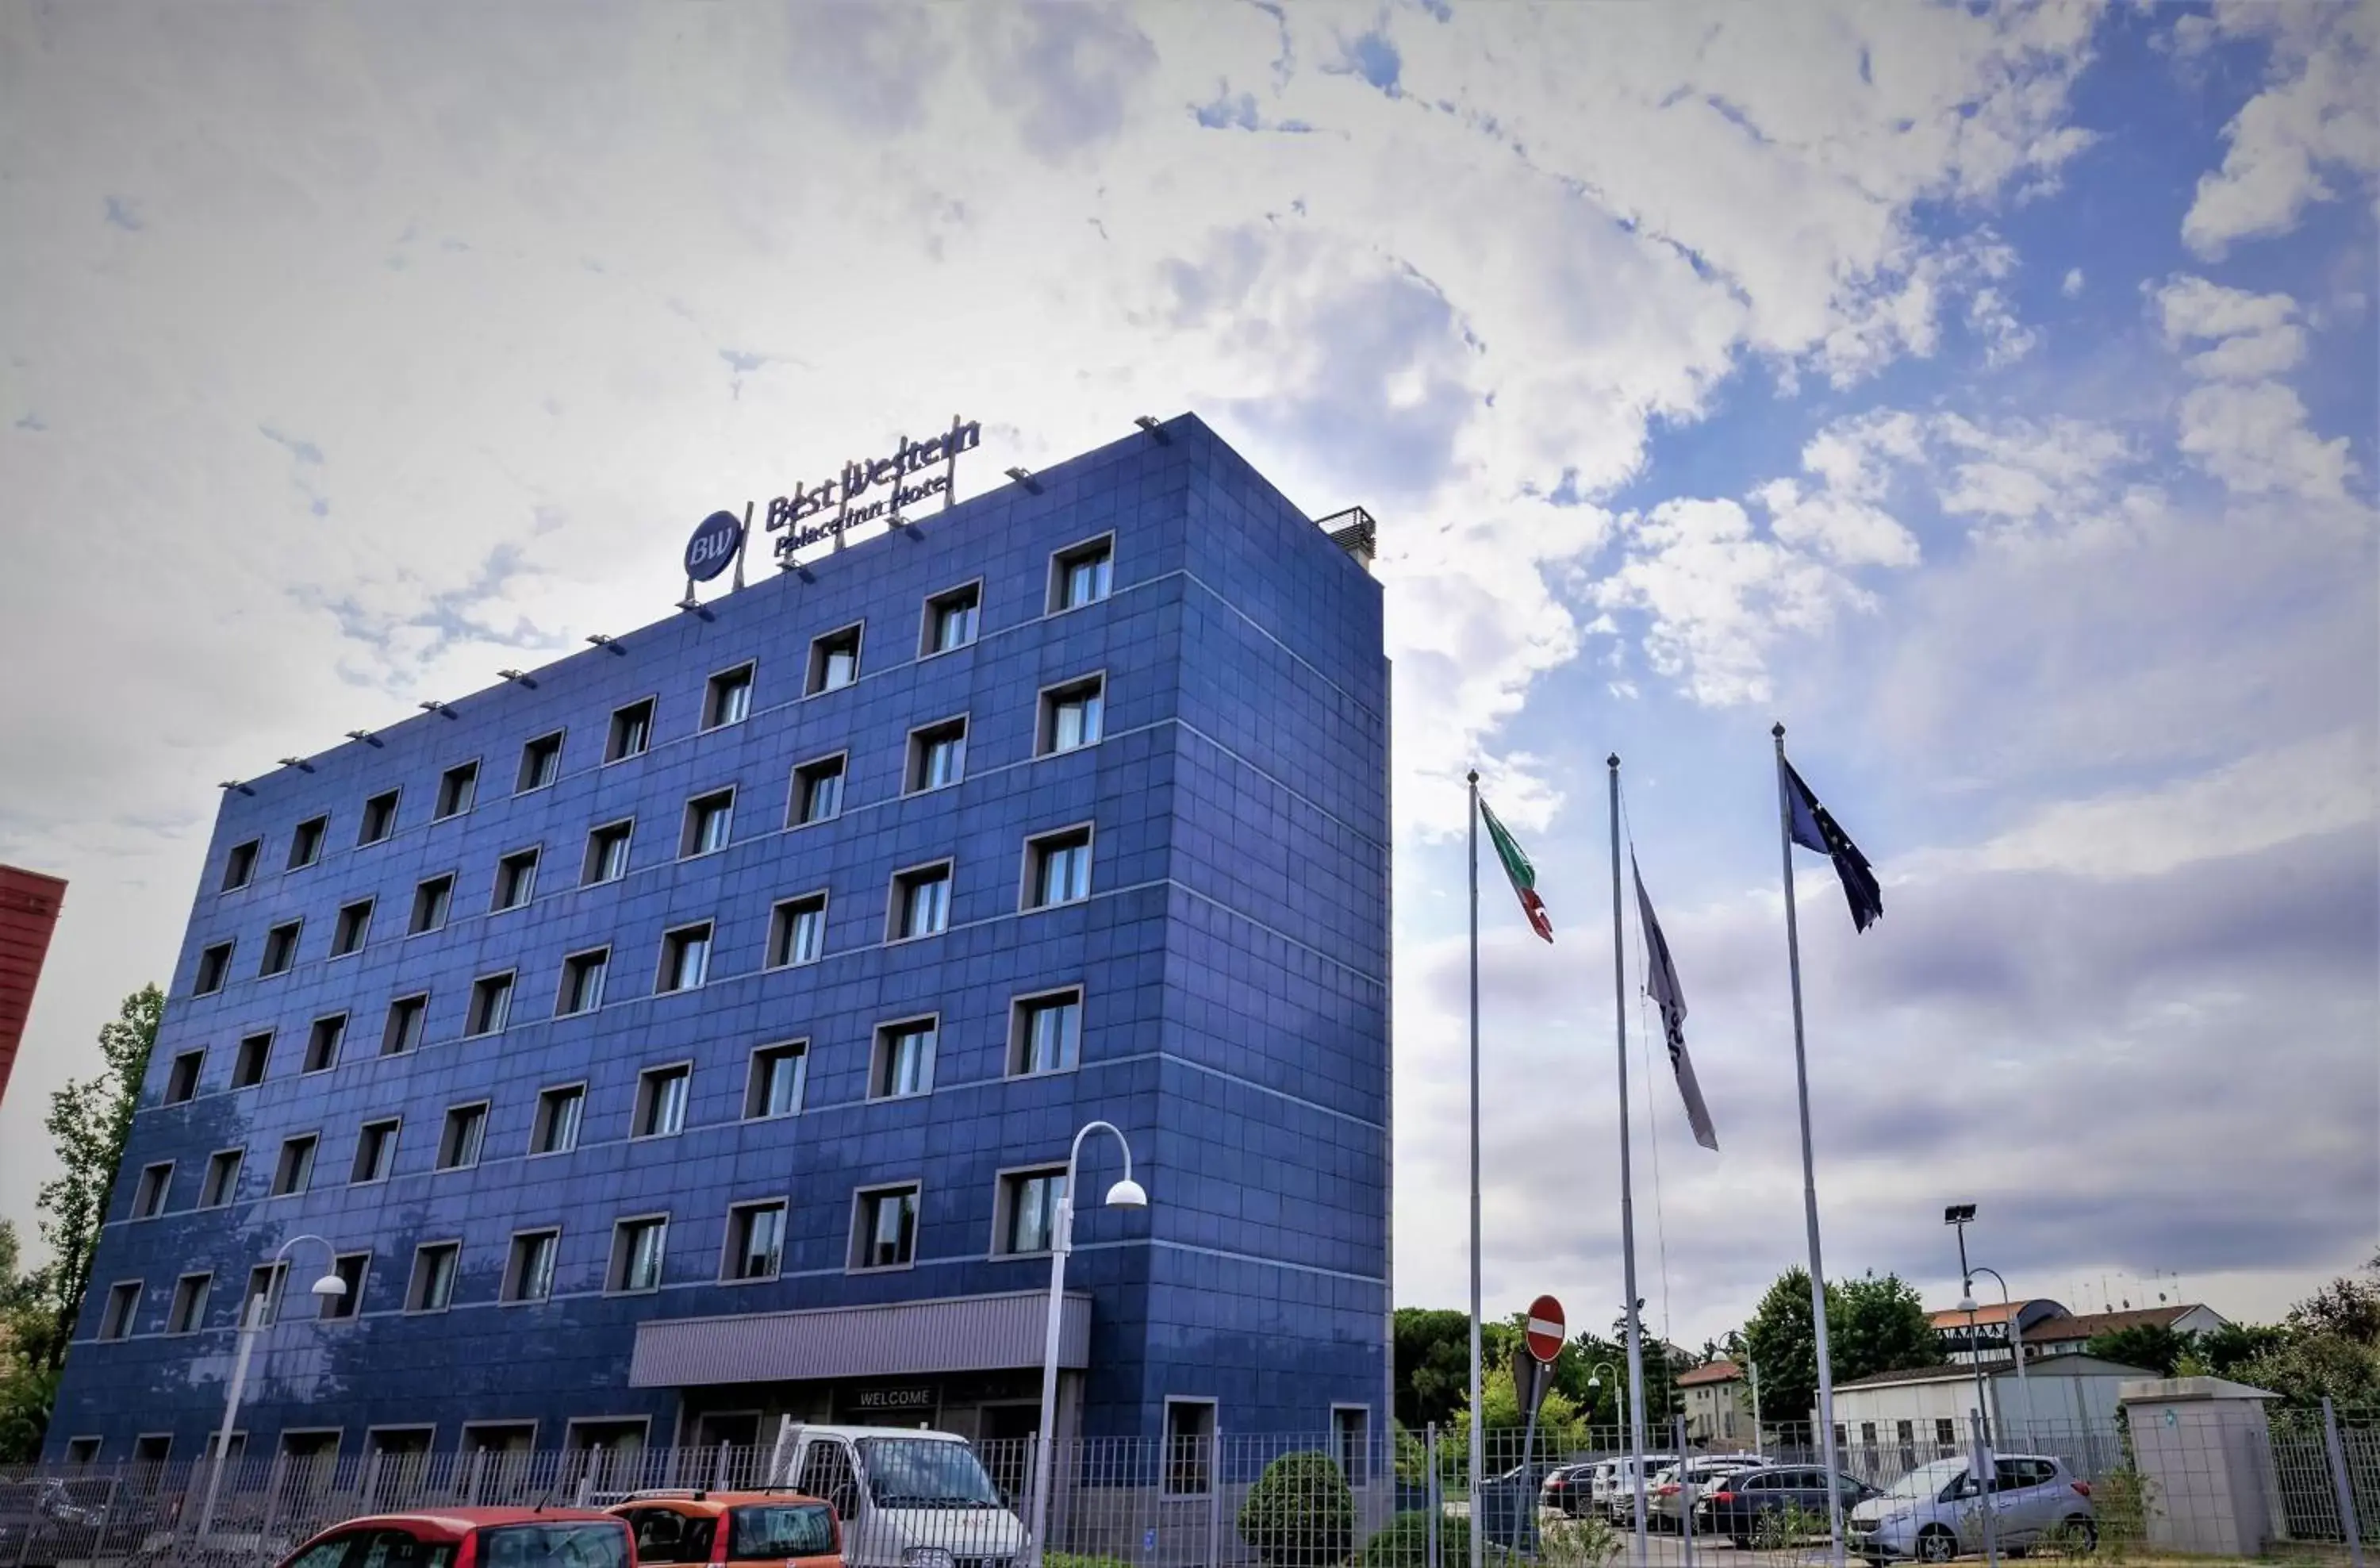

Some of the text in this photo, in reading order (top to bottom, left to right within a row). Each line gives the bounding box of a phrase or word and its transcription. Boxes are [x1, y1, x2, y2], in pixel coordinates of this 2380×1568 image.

[766, 420, 981, 532] Best Western
[774, 475, 953, 557] Palace Inn Hotel
[689, 527, 731, 566] BW
[861, 1389, 930, 1406] WELCOME
